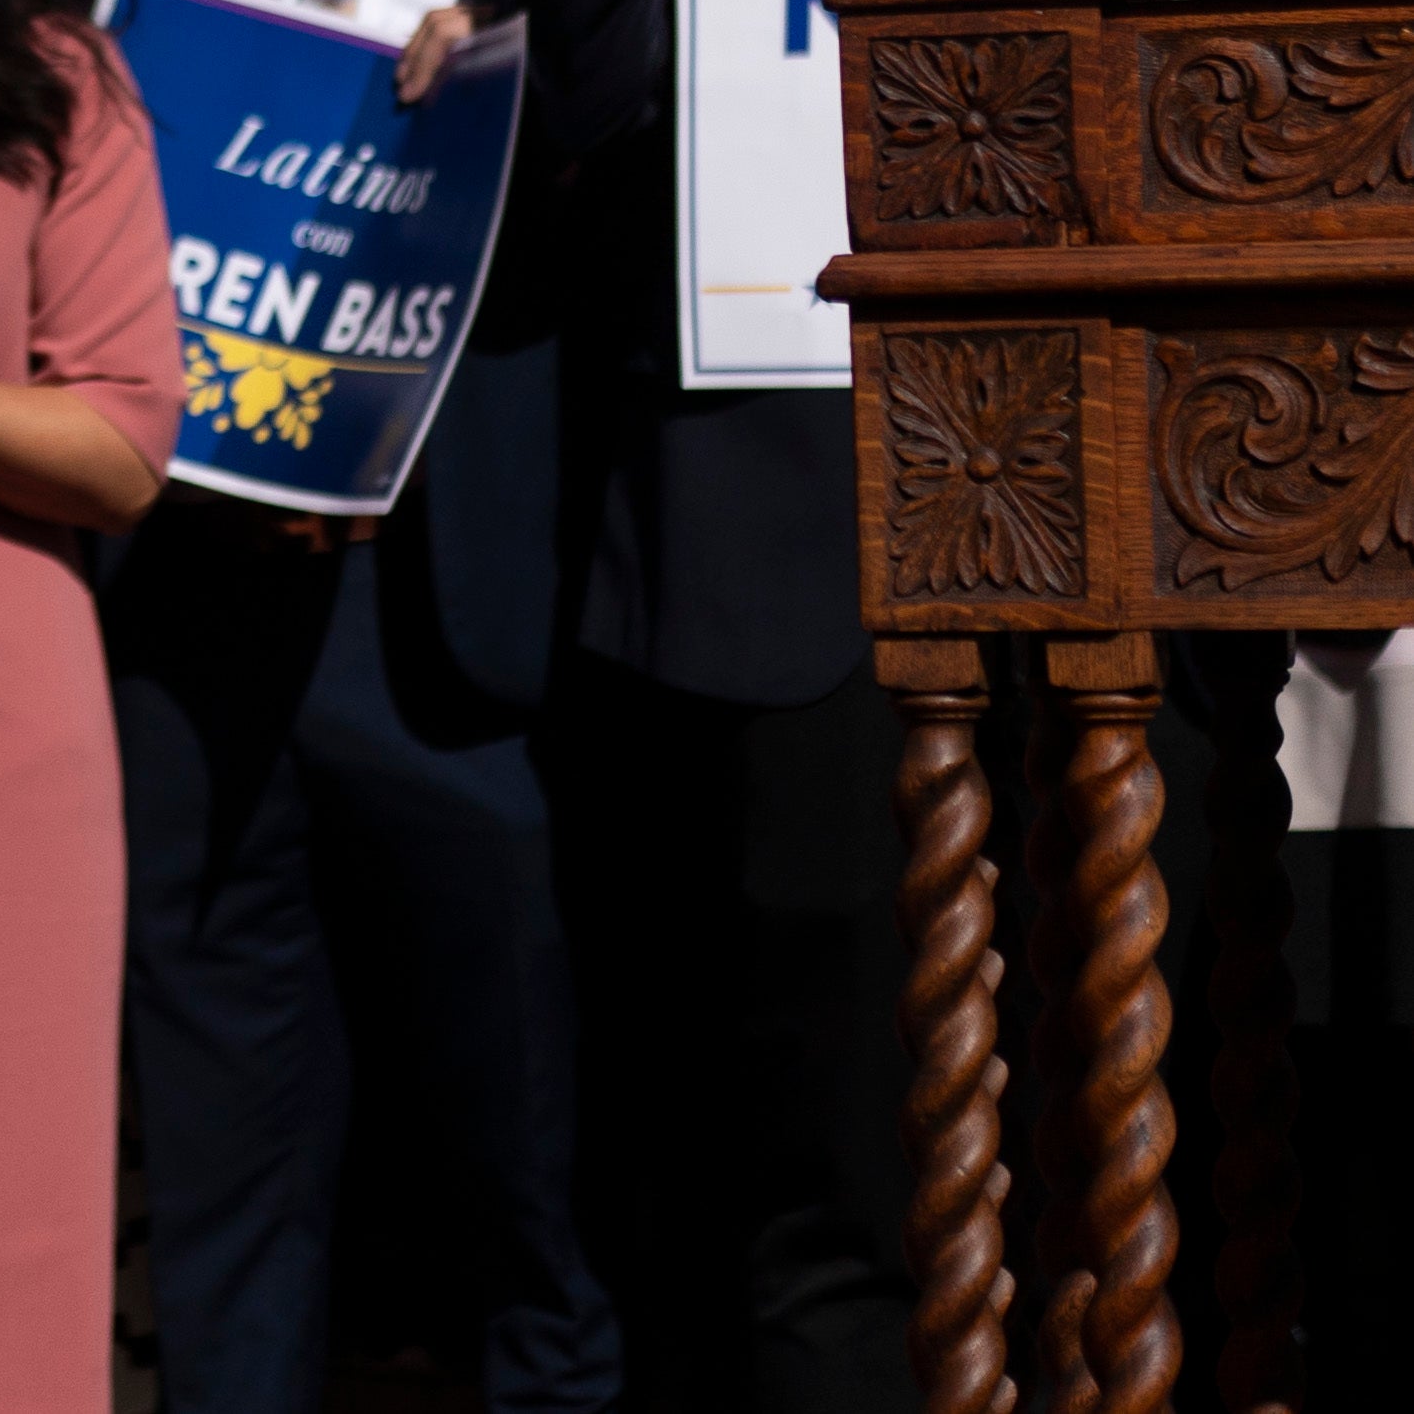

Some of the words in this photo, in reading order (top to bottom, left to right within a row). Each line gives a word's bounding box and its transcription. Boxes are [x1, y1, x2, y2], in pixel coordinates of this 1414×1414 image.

[213, 113, 439, 217] Latinos
[289, 217, 357, 260] con
[167, 233, 323, 345] REN
[321, 276, 457, 360] BASS
